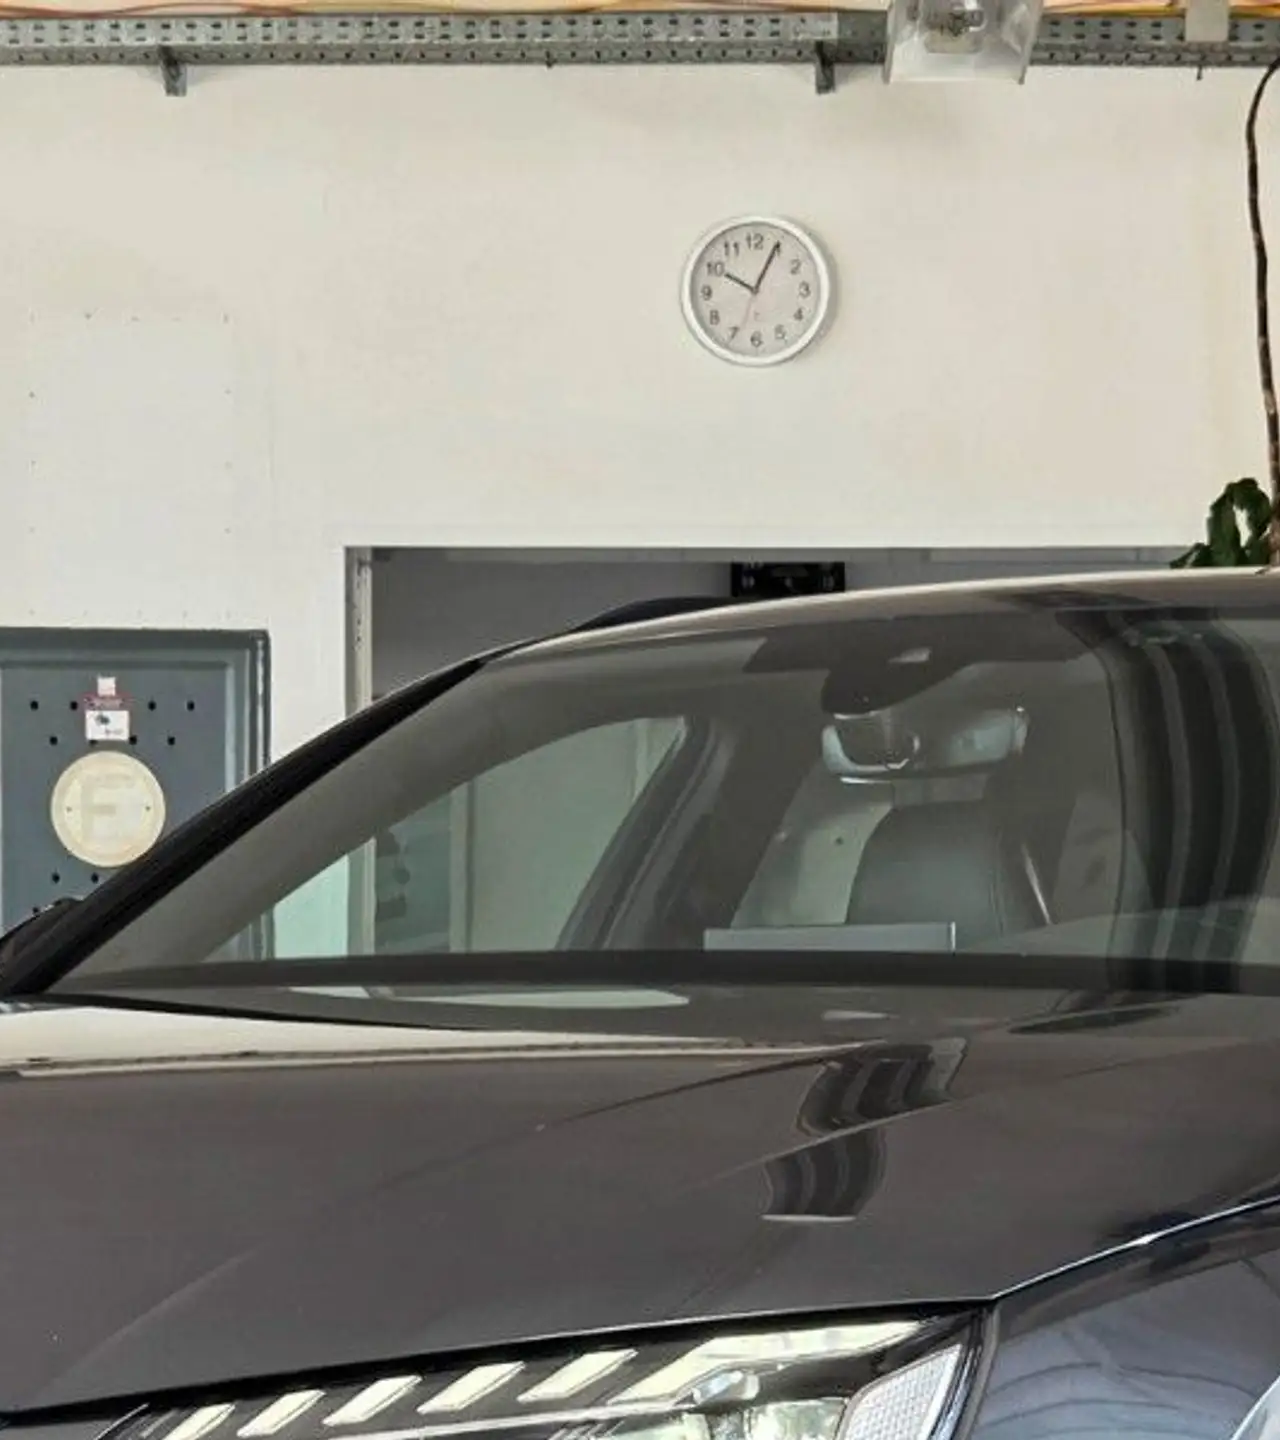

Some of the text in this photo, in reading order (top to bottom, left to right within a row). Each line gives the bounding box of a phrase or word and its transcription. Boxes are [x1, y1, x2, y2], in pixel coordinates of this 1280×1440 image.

[723, 240, 740, 256] 11
[745, 232, 764, 250] 12
[707, 261, 725, 277] 10
[790, 258, 801, 275] 2
[701, 284, 713, 301] 9
[799, 281, 811, 299] 3
[709, 309, 720, 326] 8
[793, 307, 804, 321] 4
[729, 326, 739, 340] 7
[750, 330, 763, 347] 6
[774, 324, 786, 340] 5
